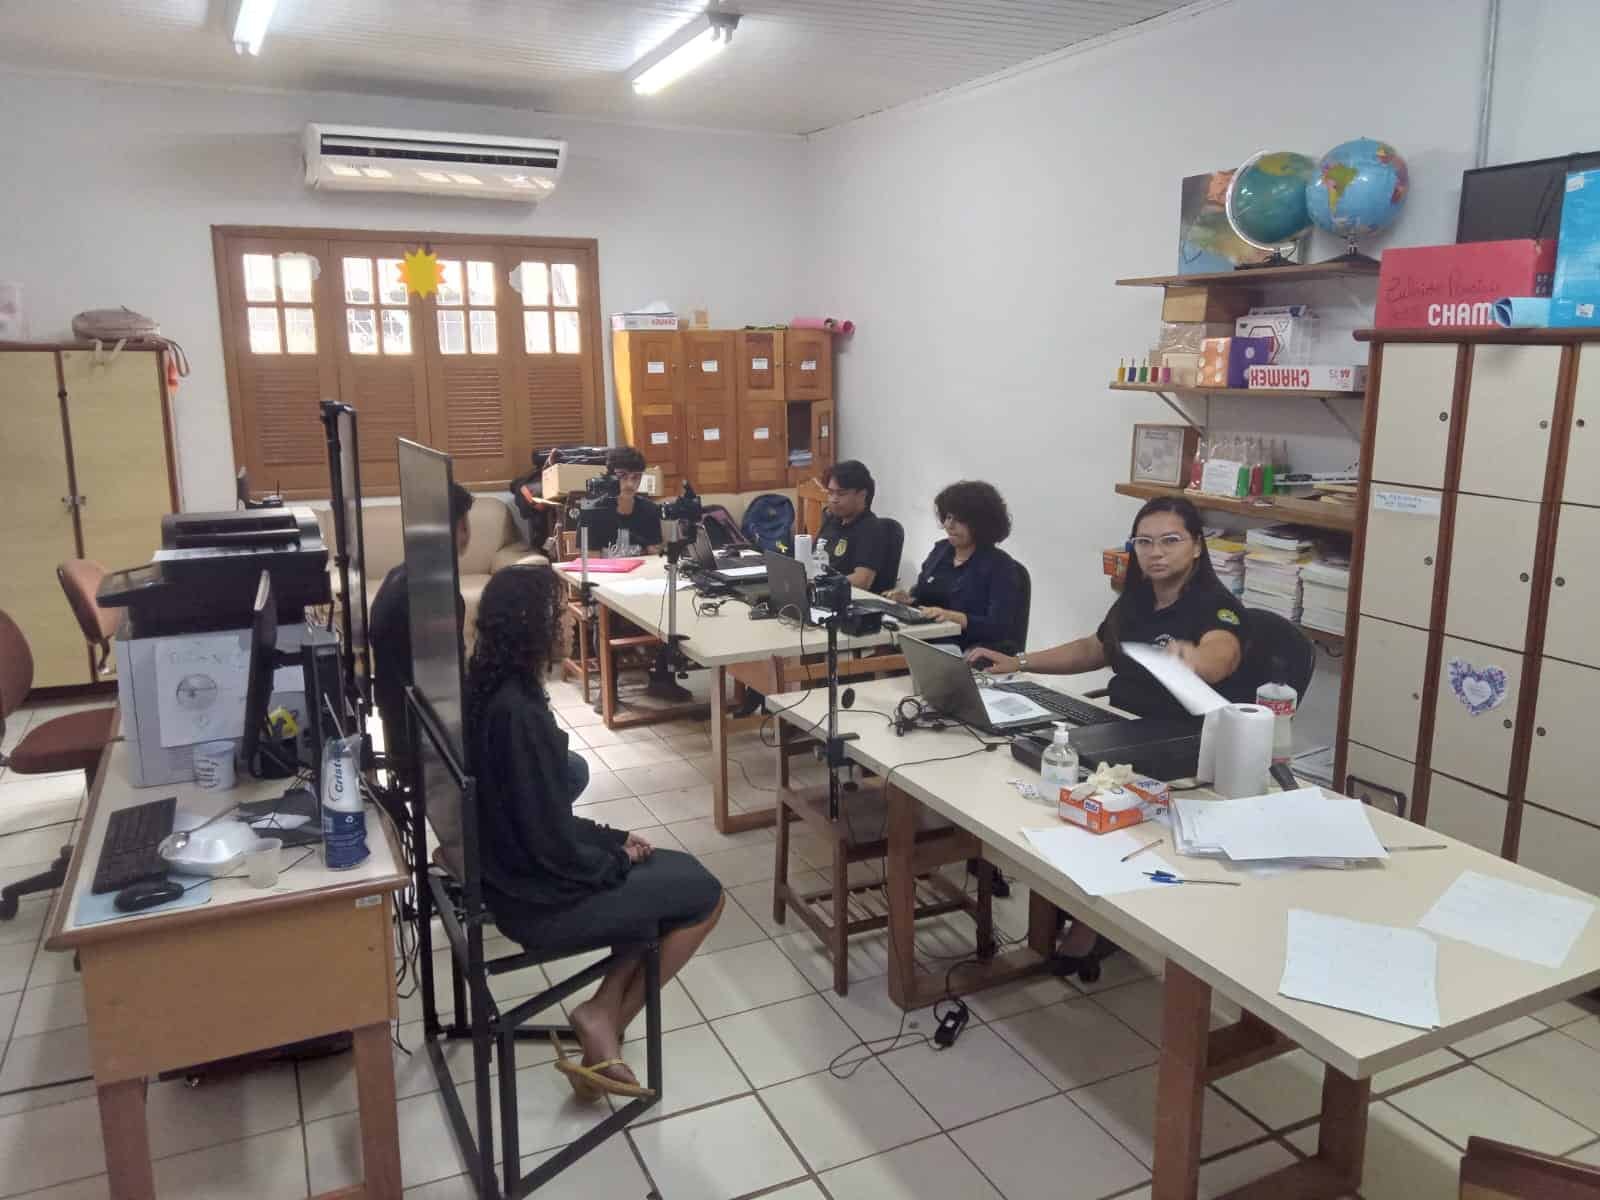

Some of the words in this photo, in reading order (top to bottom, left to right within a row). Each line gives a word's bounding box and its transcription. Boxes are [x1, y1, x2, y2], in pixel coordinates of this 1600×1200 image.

[1428, 302, 1494, 326] CHAM
[1250, 368, 1310, 387] CHAMEX
[334, 758, 344, 793] Crist
